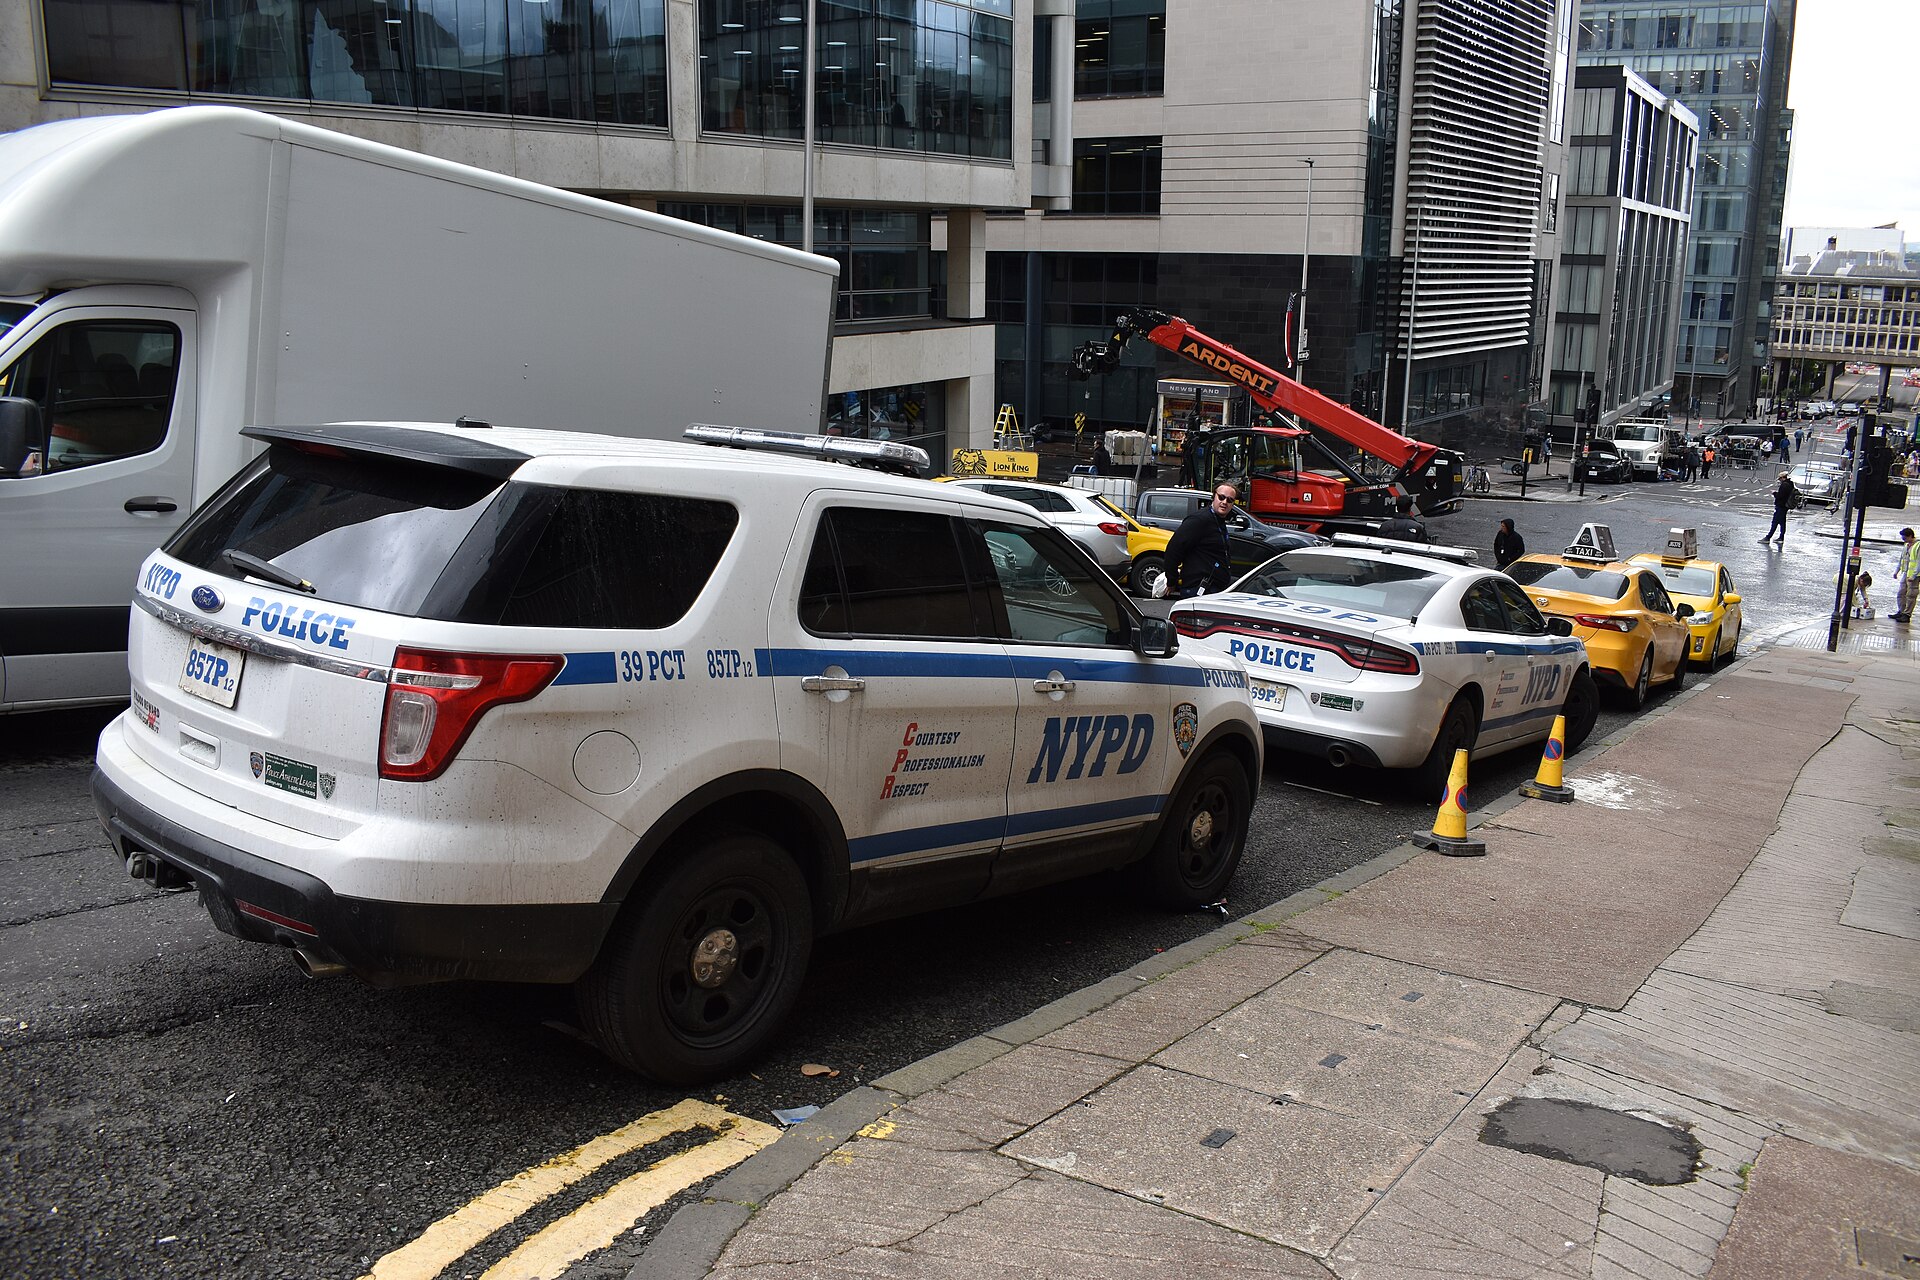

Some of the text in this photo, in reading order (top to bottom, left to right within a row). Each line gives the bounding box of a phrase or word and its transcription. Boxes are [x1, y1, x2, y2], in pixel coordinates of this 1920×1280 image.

[1183, 342, 1273, 392] ARDENT
[1170, 386, 1219, 394] NEWSSAND
[994, 462, 1029, 473] LION KING
[1576, 547, 1593, 556] TAXI
[145, 563, 181, 599] NYPD
[242, 597, 356, 650] POLICE
[621, 651, 643, 682] 39
[646, 650, 685, 680] PCT
[1230, 639, 1315, 672] POLICE
[1204, 668, 1242, 688] POLICE
[1520, 664, 1561, 705] NYPD
[903, 723, 960, 746] COURTESY
[891, 749, 985, 772] PROFESSIONALISM
[1026, 713, 1154, 784] NYPD
[266, 764, 279, 778] POLICE
[279, 769, 300, 784] ATHLETIC
[300, 775, 316, 789] LEAGUE
[880, 776, 929, 800] RESPECT
